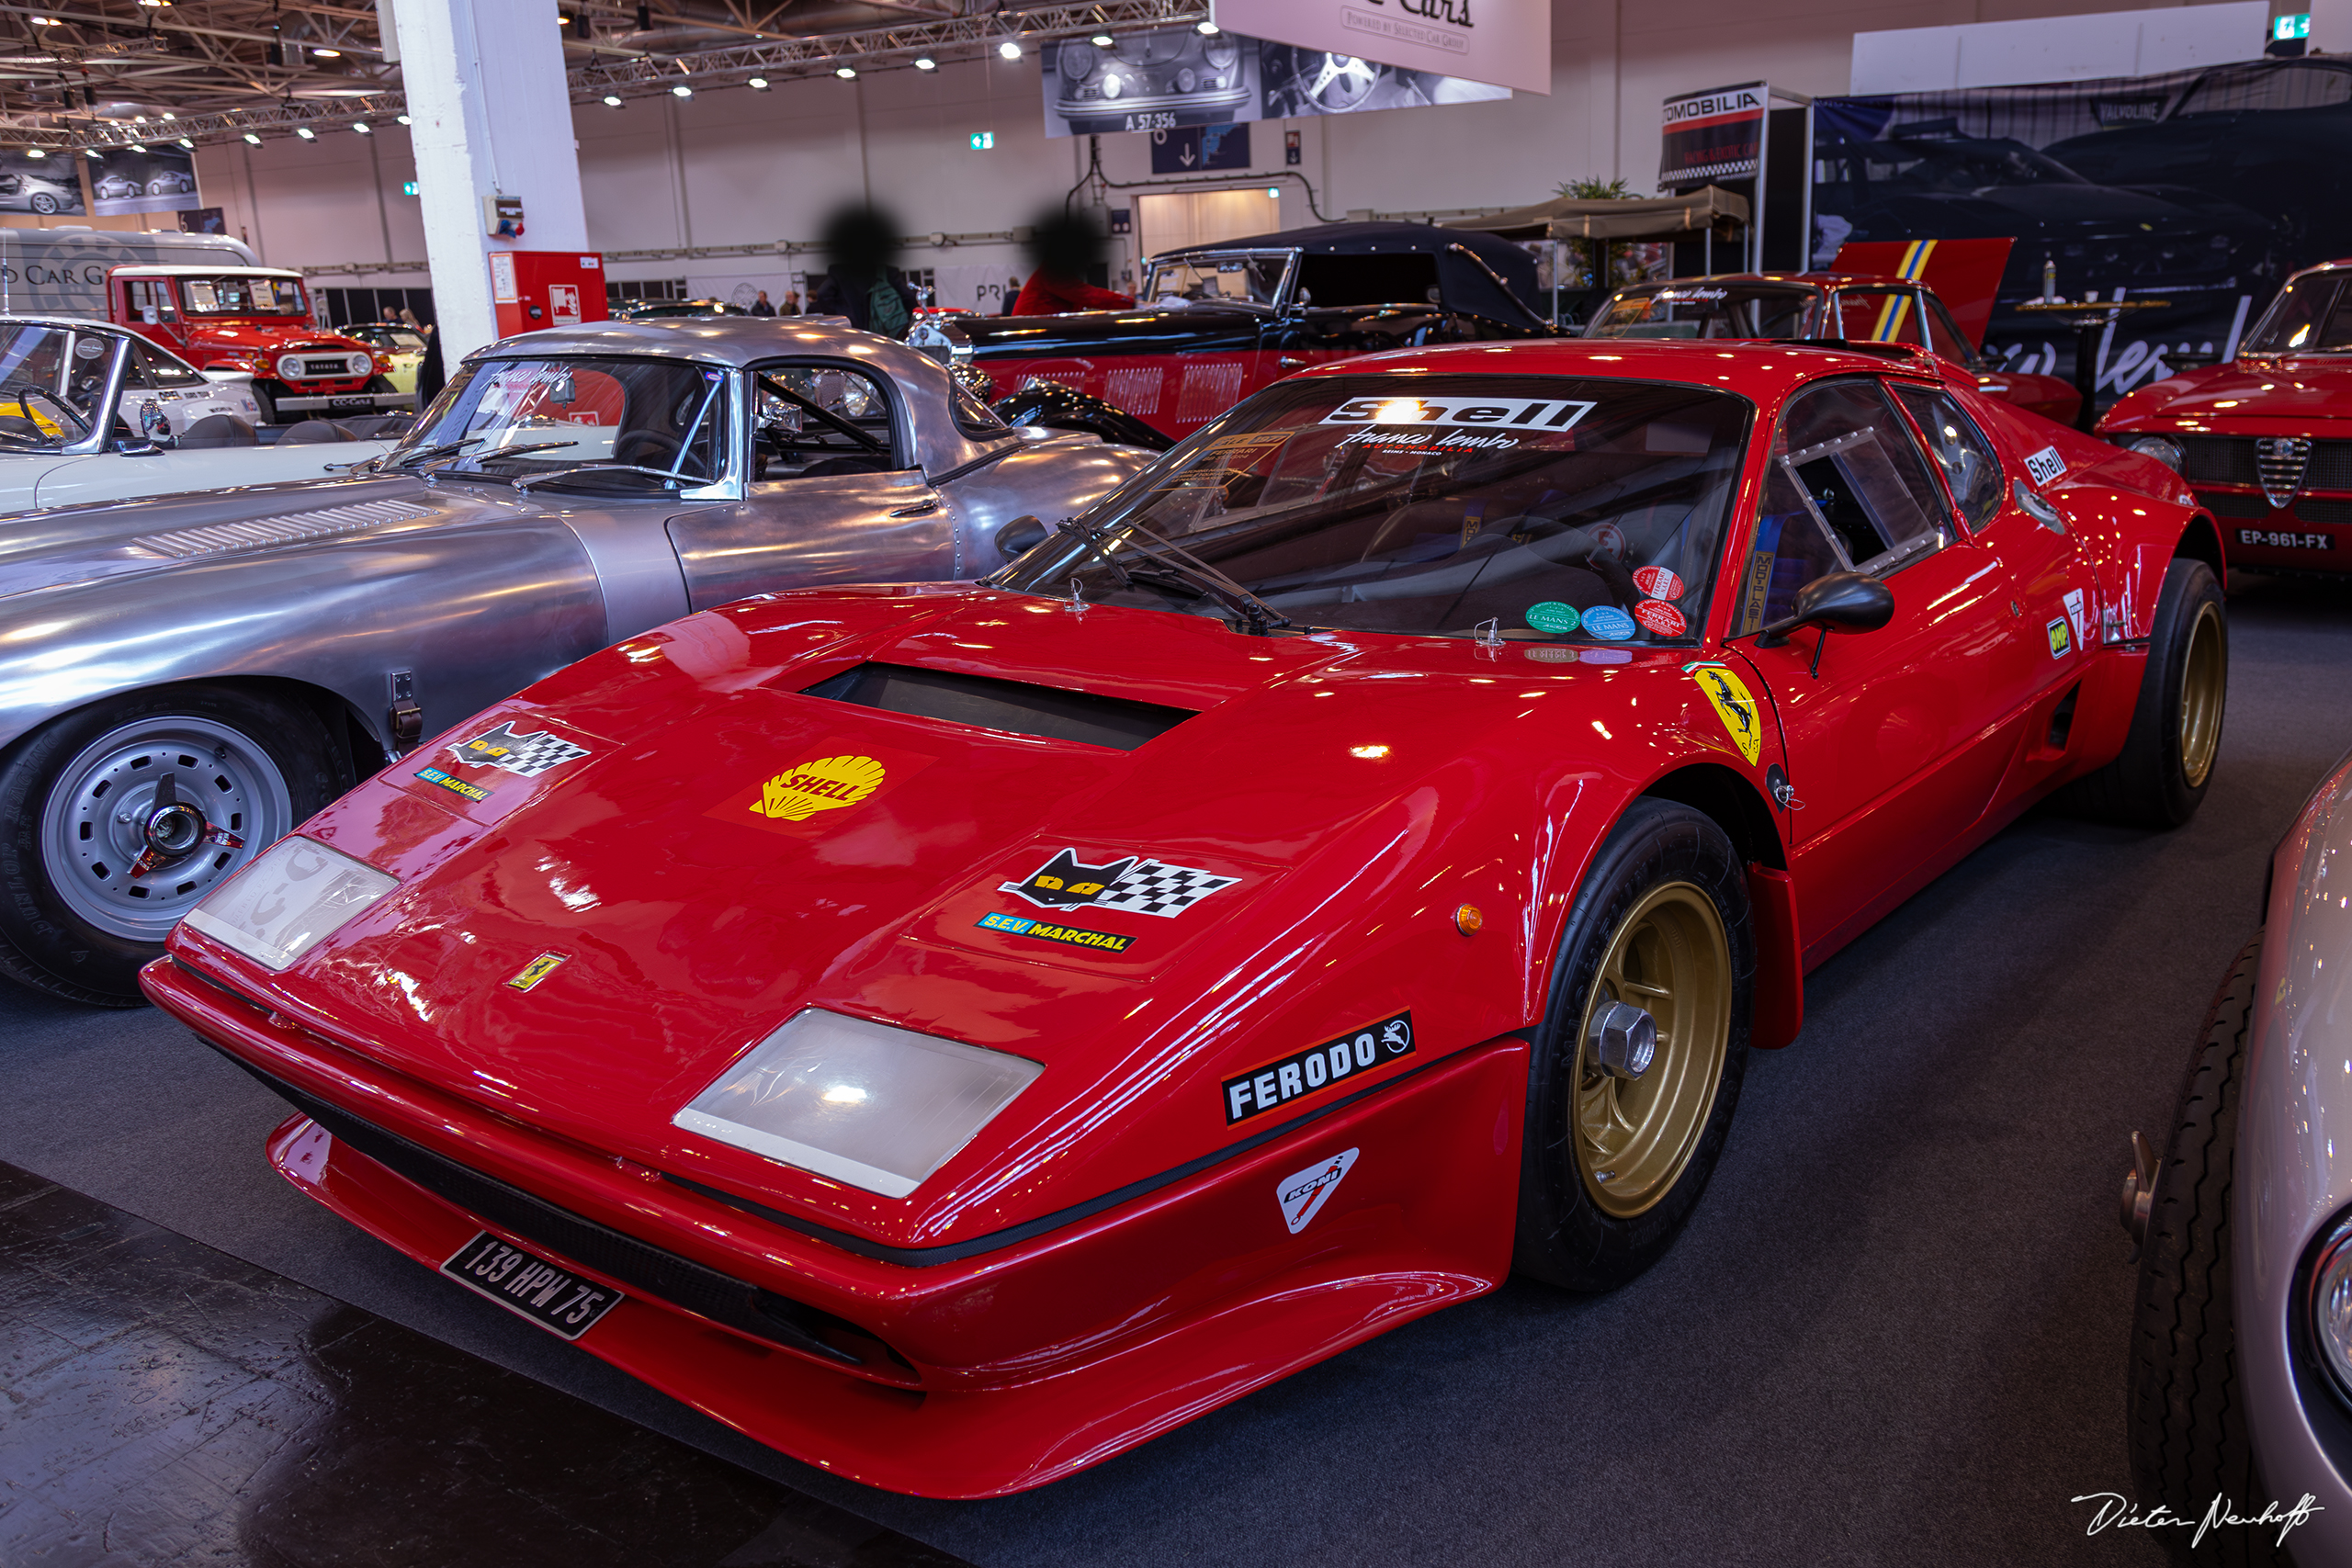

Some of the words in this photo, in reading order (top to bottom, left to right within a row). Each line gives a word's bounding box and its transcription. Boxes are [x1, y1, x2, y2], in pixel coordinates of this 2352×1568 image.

[1347, 11, 1381, 29] POWERED
[1394, 22, 1424, 39] SELECTED
[2099, 101, 2159, 121] VALVOLINE
[1329, 400, 1587, 428] Shell
[1209, 447, 1259, 456] FERRARI
[1363, 444, 1474, 454] AUTOMOBILIA
[2028, 448, 2064, 483] Shell
[2240, 529, 2328, 549] EP-961-FX
[1654, 571, 1667, 595] FERRARI
[1541, 615, 1568, 625] MANS
[1603, 622, 1630, 630] MANS
[1642, 609, 1679, 627] FERRARI
[2051, 624, 2067, 651] OMP
[419, 769, 446, 783] S.E.V.
[438, 776, 489, 800] MARCHAL
[780, 774, 860, 801] SHELL
[984, 915, 1027, 933] S.E.V.
[1027, 923, 1127, 950] MARCHAL
[1229, 1033, 1376, 1119] FERODO
[1289, 1169, 1339, 1201] KONI
[464, 1241, 524, 1282] 139
[504, 1261, 571, 1308] HPW
[550, 1285, 605, 1324] 75
